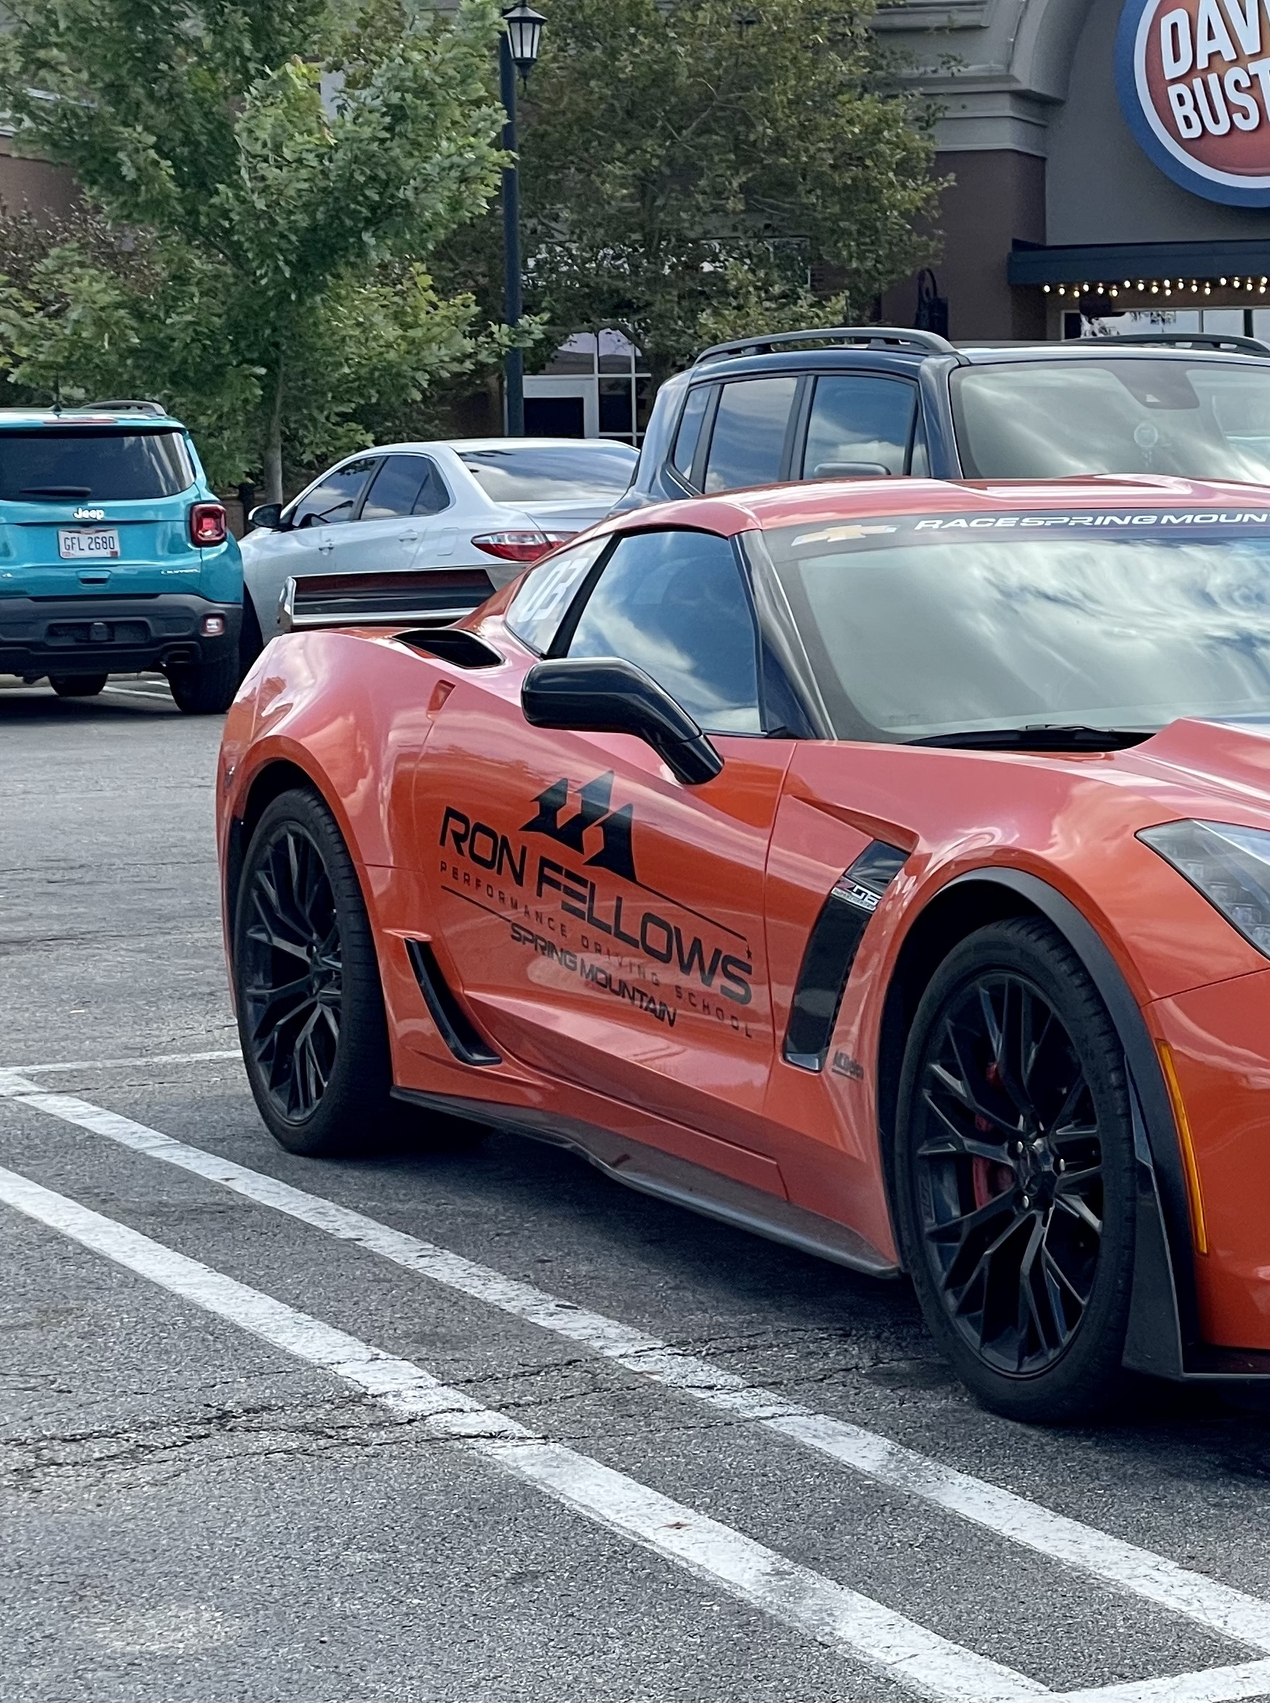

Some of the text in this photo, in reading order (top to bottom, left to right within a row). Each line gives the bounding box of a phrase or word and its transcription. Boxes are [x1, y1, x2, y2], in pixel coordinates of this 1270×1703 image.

[64, 535, 116, 551] GFL 2680
[73, 507, 105, 521] Jeep
[517, 557, 590, 623] 03
[438, 806, 753, 1005] RON FELLOWS
[440, 860, 753, 1039] PERFORMANCE DRIVING SCHOOL
[510, 922, 677, 1028] SPRING MOUNTAIN
